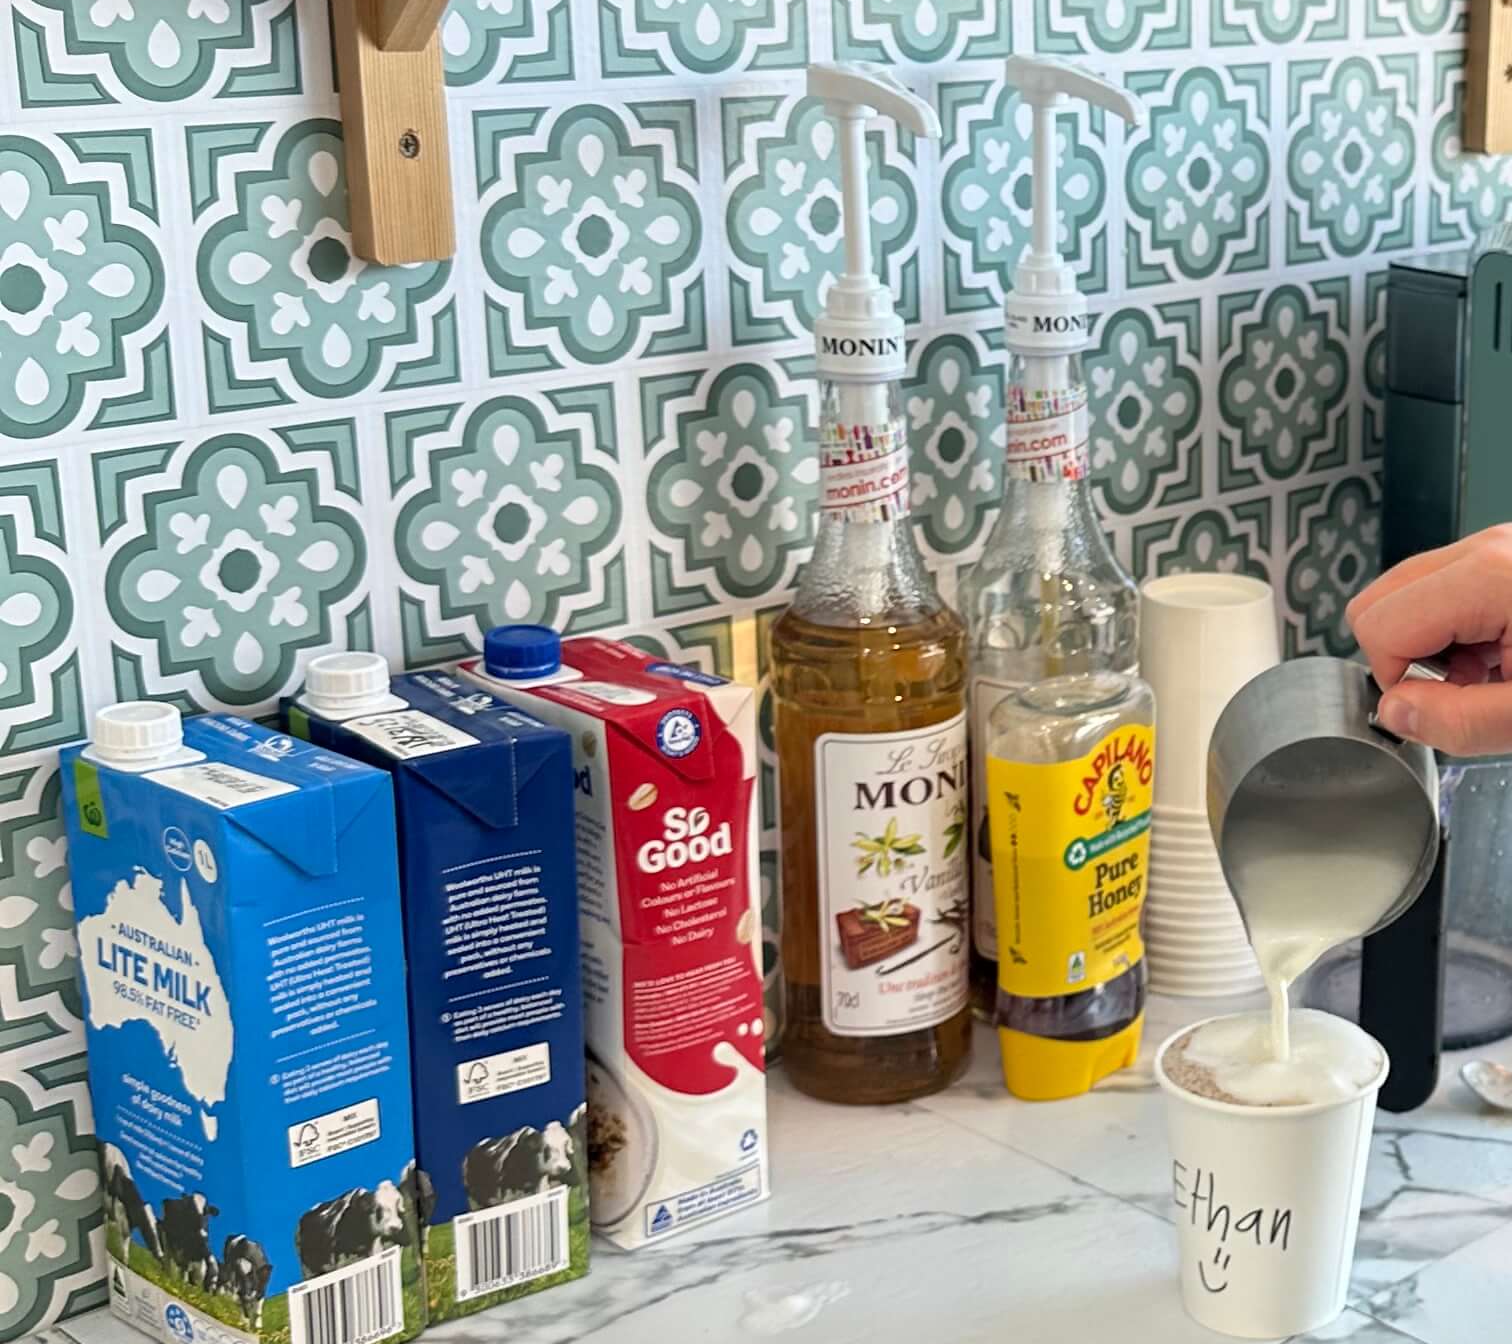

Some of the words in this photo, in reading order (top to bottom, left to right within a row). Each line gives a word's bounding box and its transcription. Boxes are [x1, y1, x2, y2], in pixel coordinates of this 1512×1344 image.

[821, 335, 901, 356] MONIN
[853, 760, 964, 811] MONI
[1073, 734, 1153, 816] CAPILANO
[663, 806, 711, 842] So
[198, 849, 214, 870] 1L
[637, 821, 734, 874] Good
[660, 881, 677, 893] No
[677, 869, 719, 888] Artificial
[1095, 852, 1139, 889] Pure
[640, 892, 683, 909] Colours
[683, 889, 695, 899] or
[694, 877, 736, 895] Flavours
[663, 907, 680, 919] No
[681, 897, 719, 914] Lactose
[1088, 874, 1143, 919] Honey
[655, 924, 672, 935] No
[673, 907, 728, 930] Cholesterol
[671, 934, 688, 946] No
[688, 927, 715, 940] Dairy
[118, 922, 193, 967] AUSTRALIAN
[97, 937, 149, 986] LITE
[153, 962, 212, 1017] MILK
[113, 980, 145, 1006] 98.5%
[145, 997, 166, 1017] FAT
[122, 1072, 150, 1094] simple
[151, 1088, 193, 1116] goodness
[1173, 1159, 1292, 1251] Ethan
